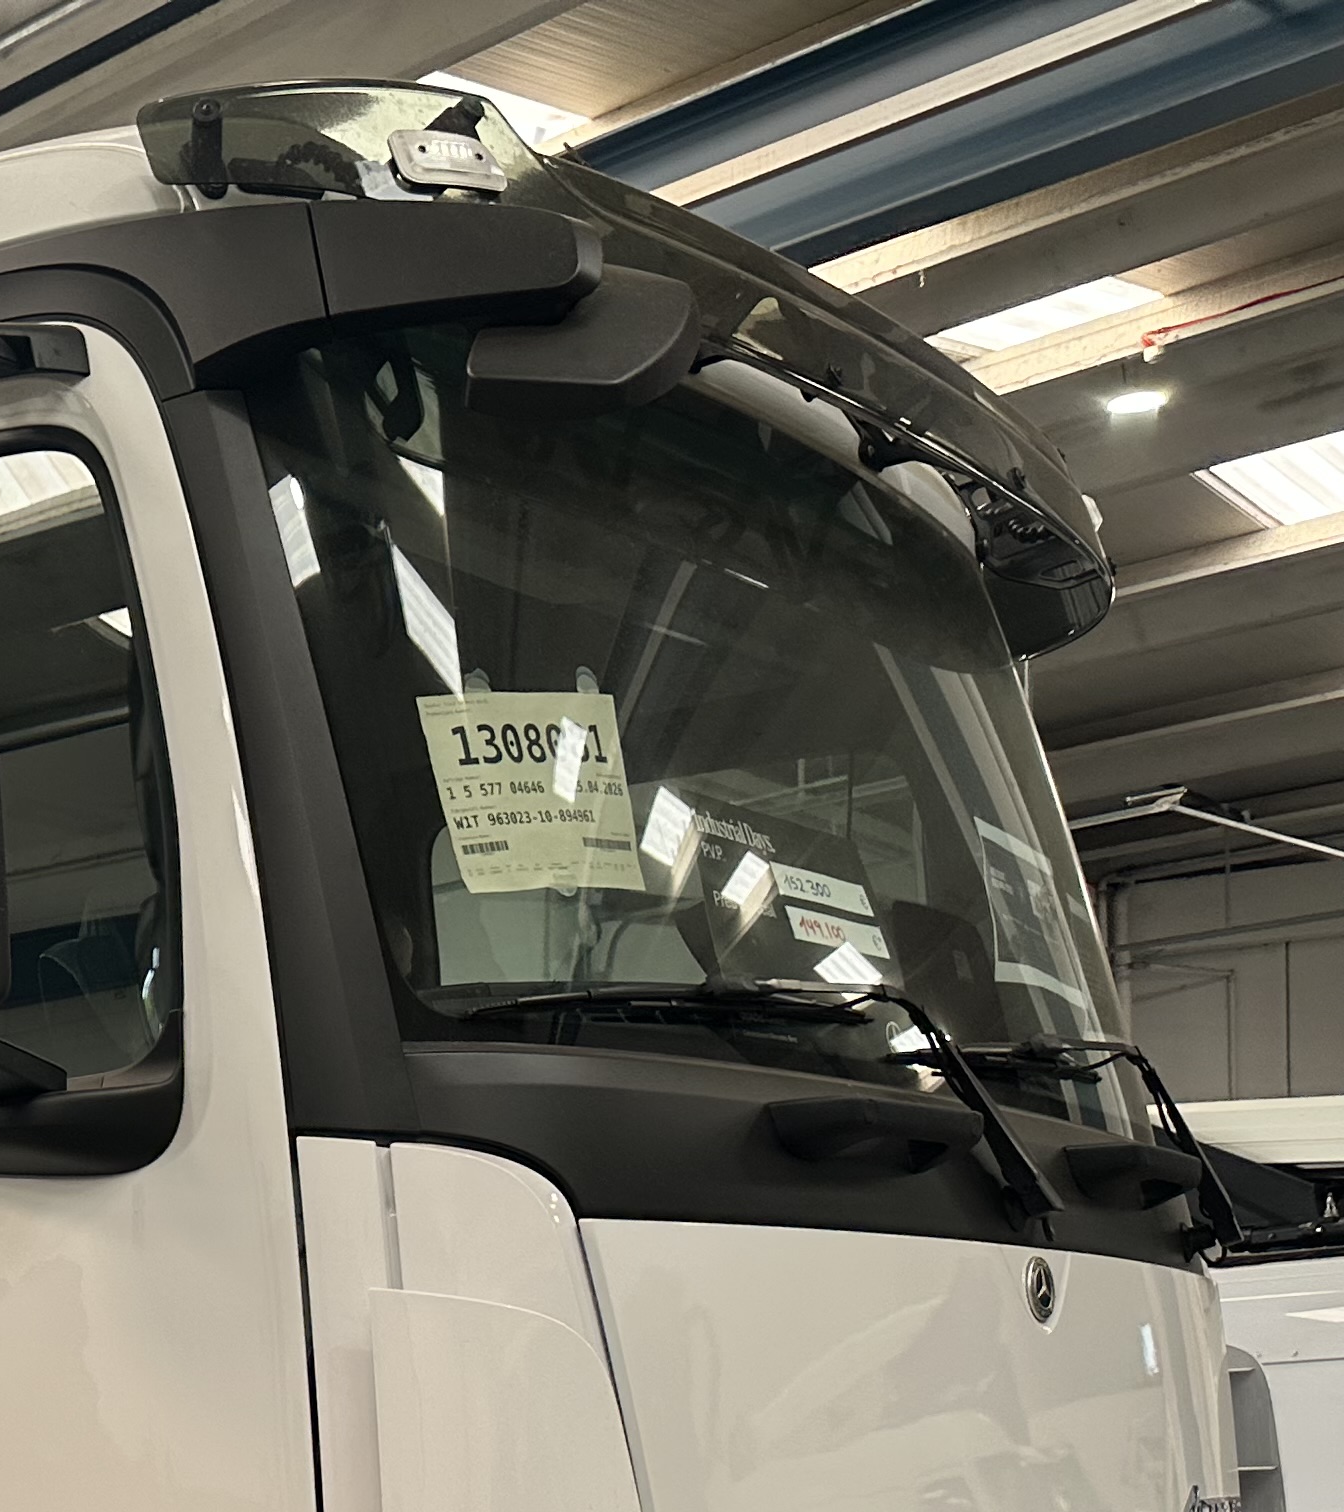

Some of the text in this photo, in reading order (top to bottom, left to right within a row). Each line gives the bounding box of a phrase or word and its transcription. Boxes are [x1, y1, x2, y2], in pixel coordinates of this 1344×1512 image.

[450, 722, 608, 766] 130801
[446, 786, 457, 800] 1
[463, 785, 473, 798] 5
[479, 782, 503, 796] 577
[509, 780, 545, 795] 04646
